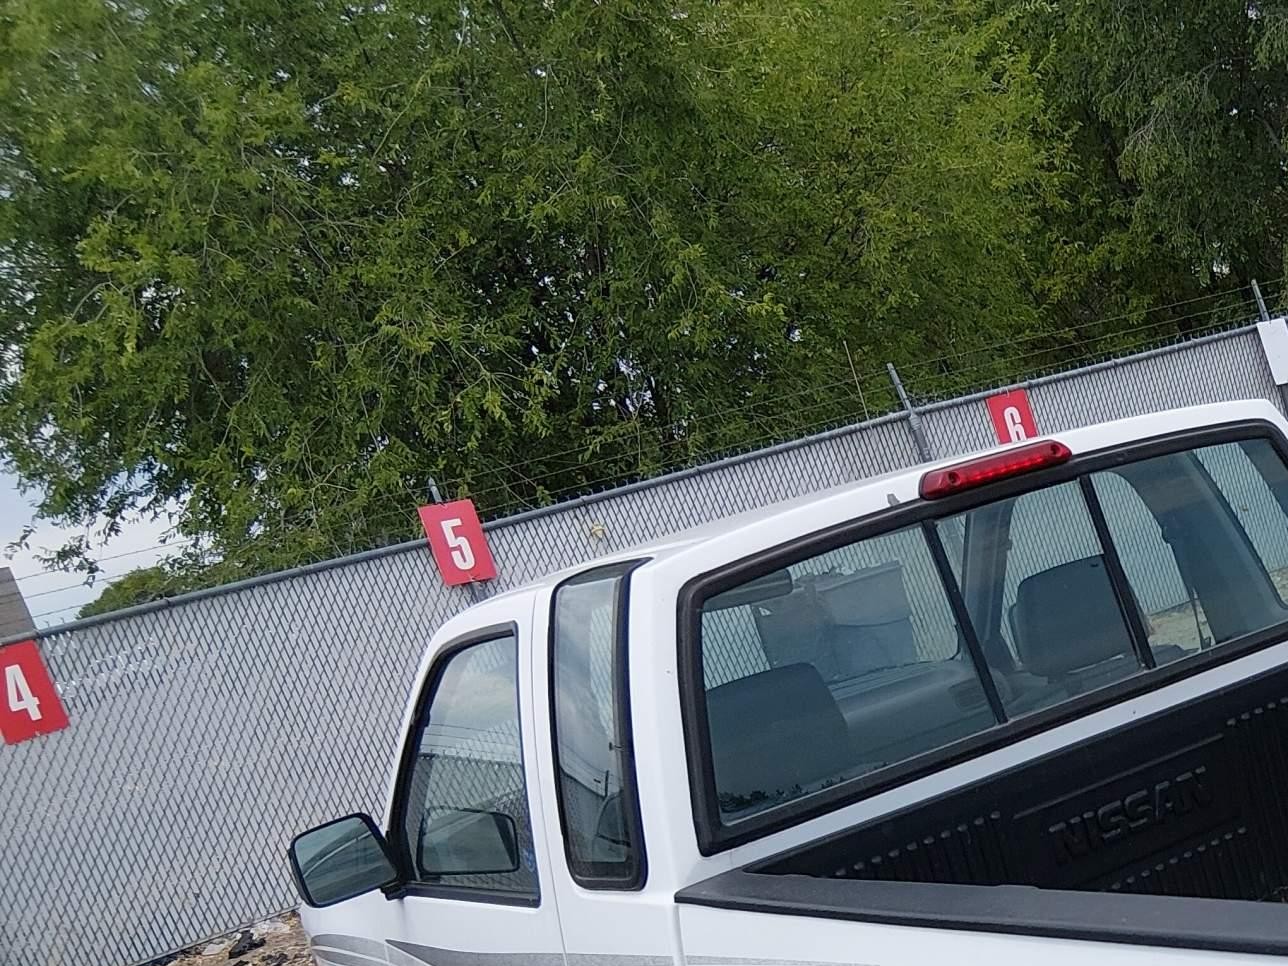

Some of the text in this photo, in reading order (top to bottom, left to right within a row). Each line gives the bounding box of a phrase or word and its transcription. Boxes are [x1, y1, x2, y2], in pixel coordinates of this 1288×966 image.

[1003, 406, 1027, 443] 6
[440, 518, 475, 571] 5
[5, 664, 42, 721] 4
[1048, 765, 1213, 864] NISSAN
